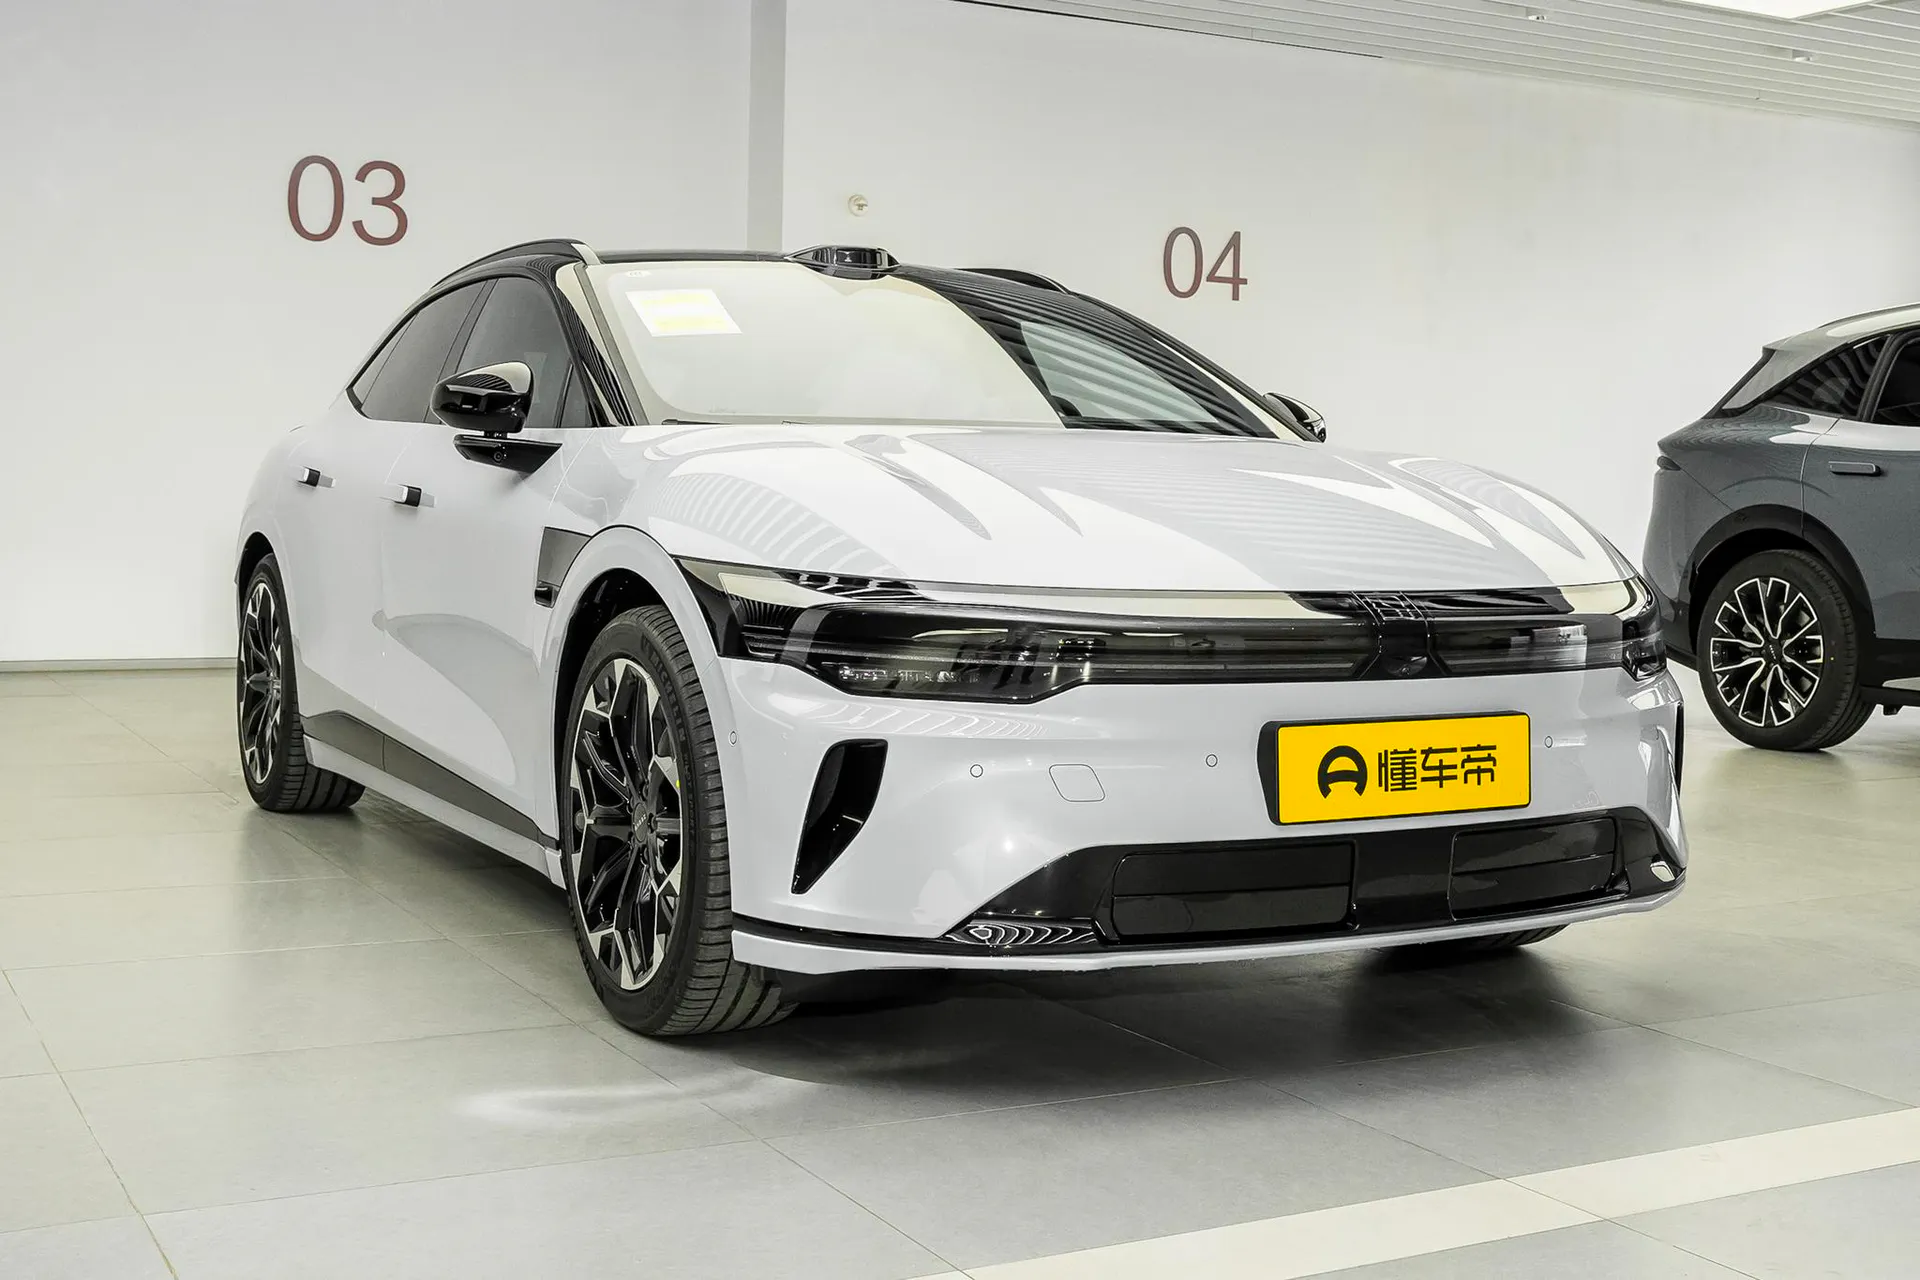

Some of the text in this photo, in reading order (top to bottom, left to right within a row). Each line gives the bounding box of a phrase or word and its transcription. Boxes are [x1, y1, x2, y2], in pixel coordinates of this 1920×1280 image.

[287, 155, 408, 246] 03
[1163, 226, 1248, 301] 04
[1377, 744, 1497, 792] 懂车帝
